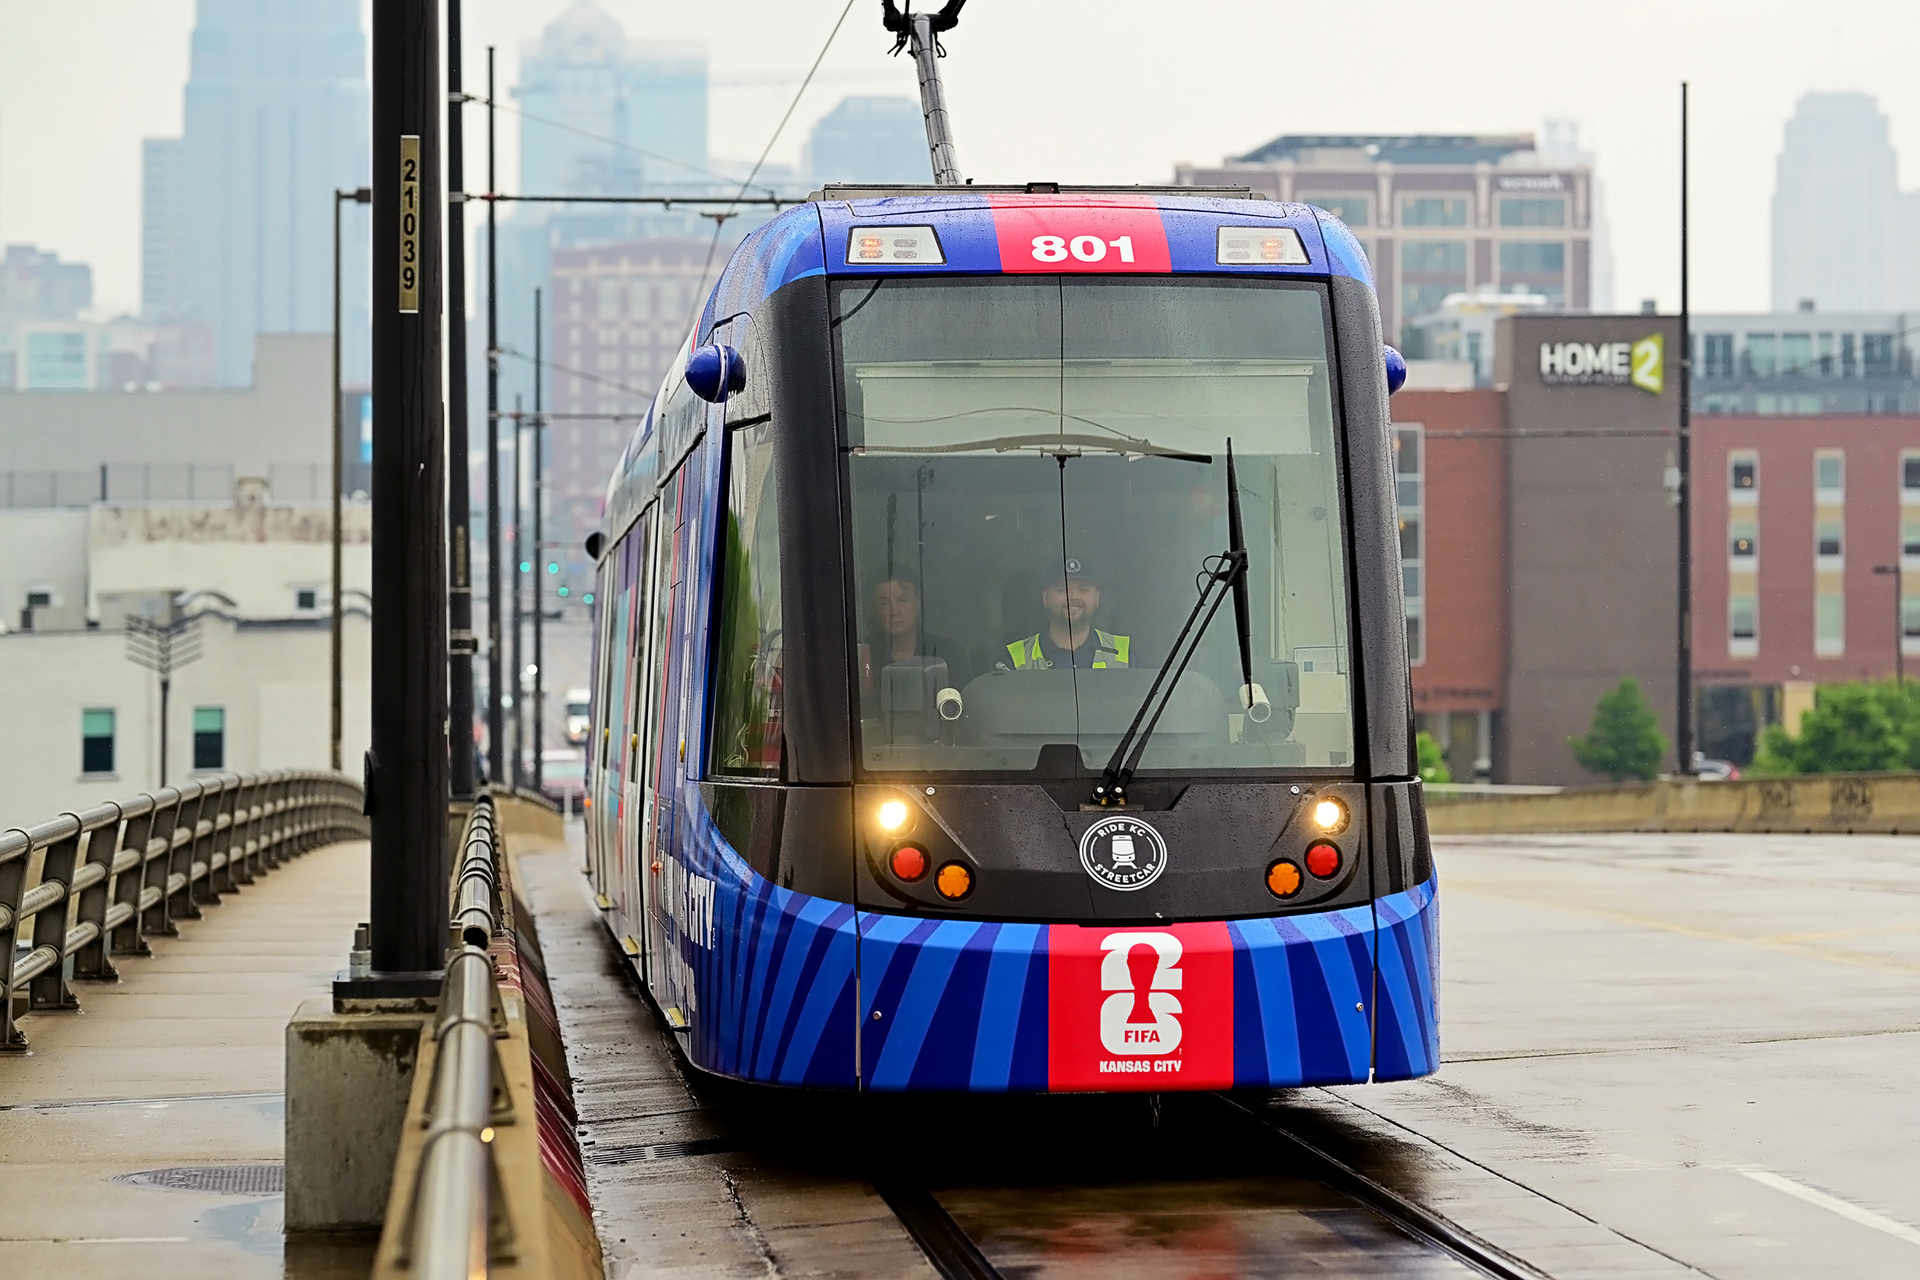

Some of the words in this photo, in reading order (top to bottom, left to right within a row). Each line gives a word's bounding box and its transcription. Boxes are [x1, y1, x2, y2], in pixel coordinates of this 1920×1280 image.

[403, 158, 416, 290] 21039
[1031, 235, 1134, 263] 801
[1097, 823, 1125, 837] RIDE
[1129, 825, 1146, 837] KC
[1094, 863, 1156, 883] STREETCAR
[689, 872, 716, 950] CITY
[1124, 1030, 1161, 1043] FIFA
[1099, 1060, 1151, 1073] KANSAS
[1153, 1060, 1182, 1072] CITY
